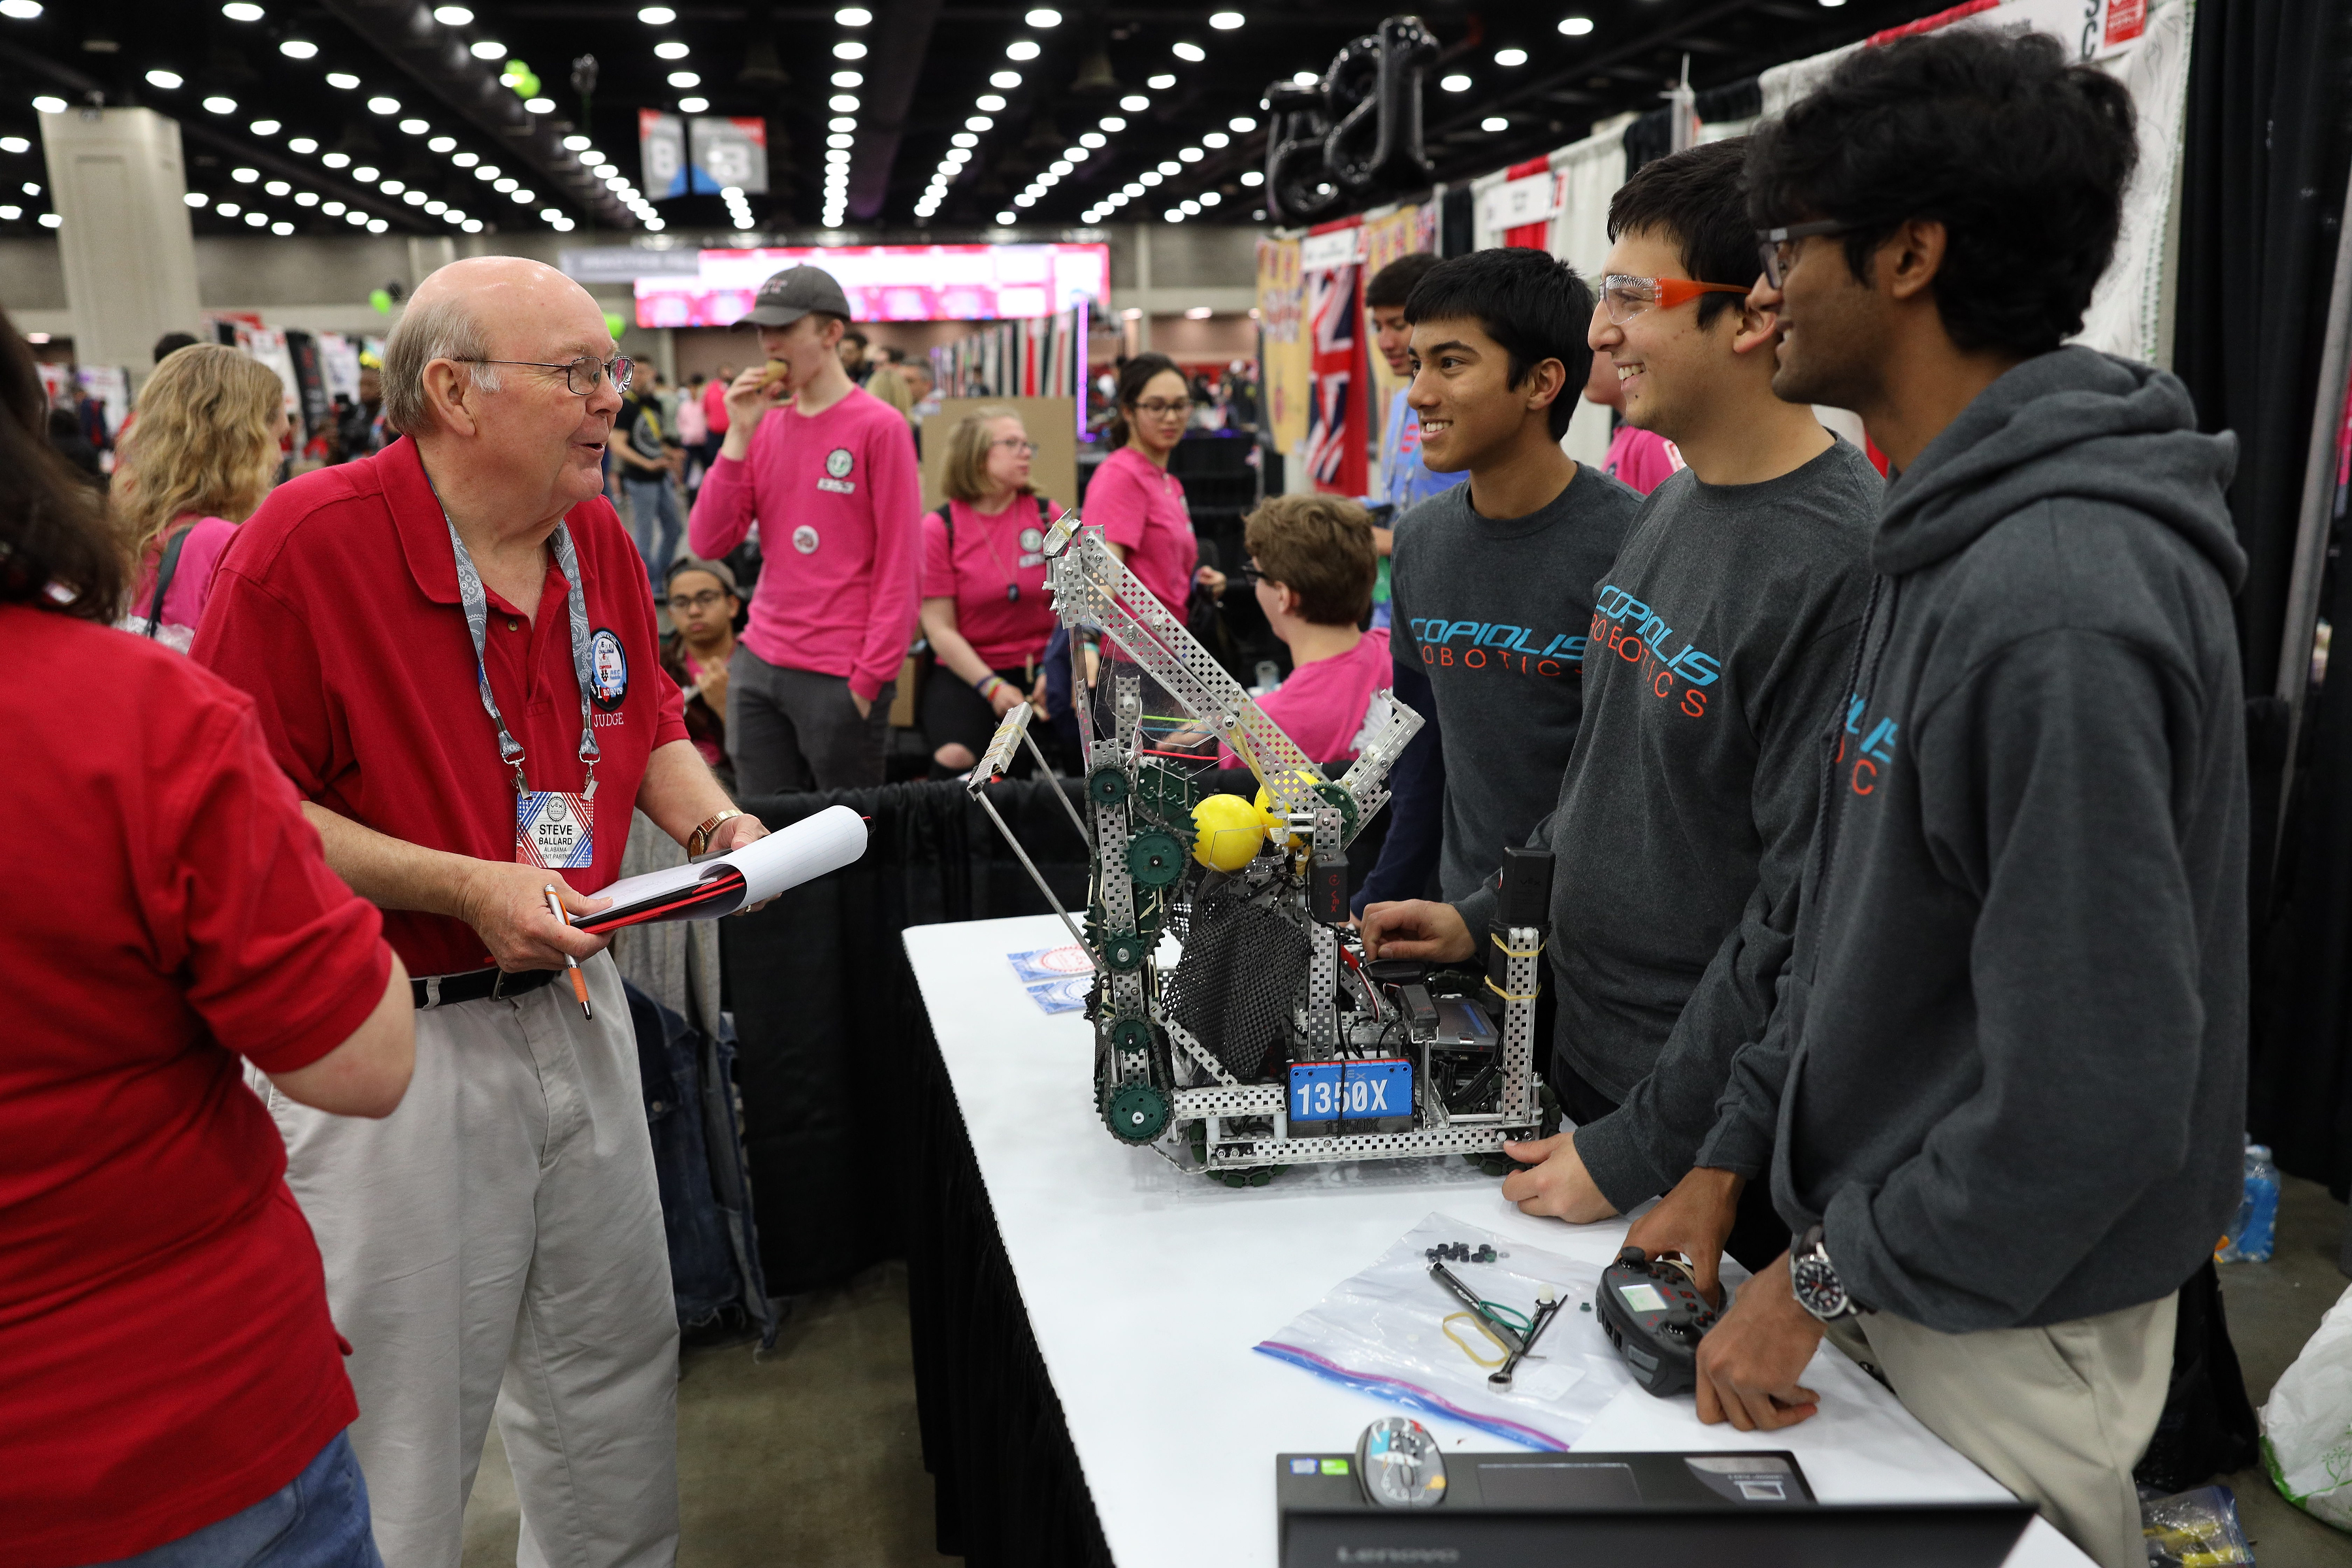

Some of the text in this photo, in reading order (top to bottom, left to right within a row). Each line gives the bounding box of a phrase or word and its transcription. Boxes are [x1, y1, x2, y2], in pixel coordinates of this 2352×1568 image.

[1422, 645, 1584, 676] OBOTIC
[593, 712, 624, 728] JUDGE
[539, 824, 573, 835] STEVE
[1331, 890, 1339, 913] VEX
[1297, 1079, 1388, 1115] 1350X
